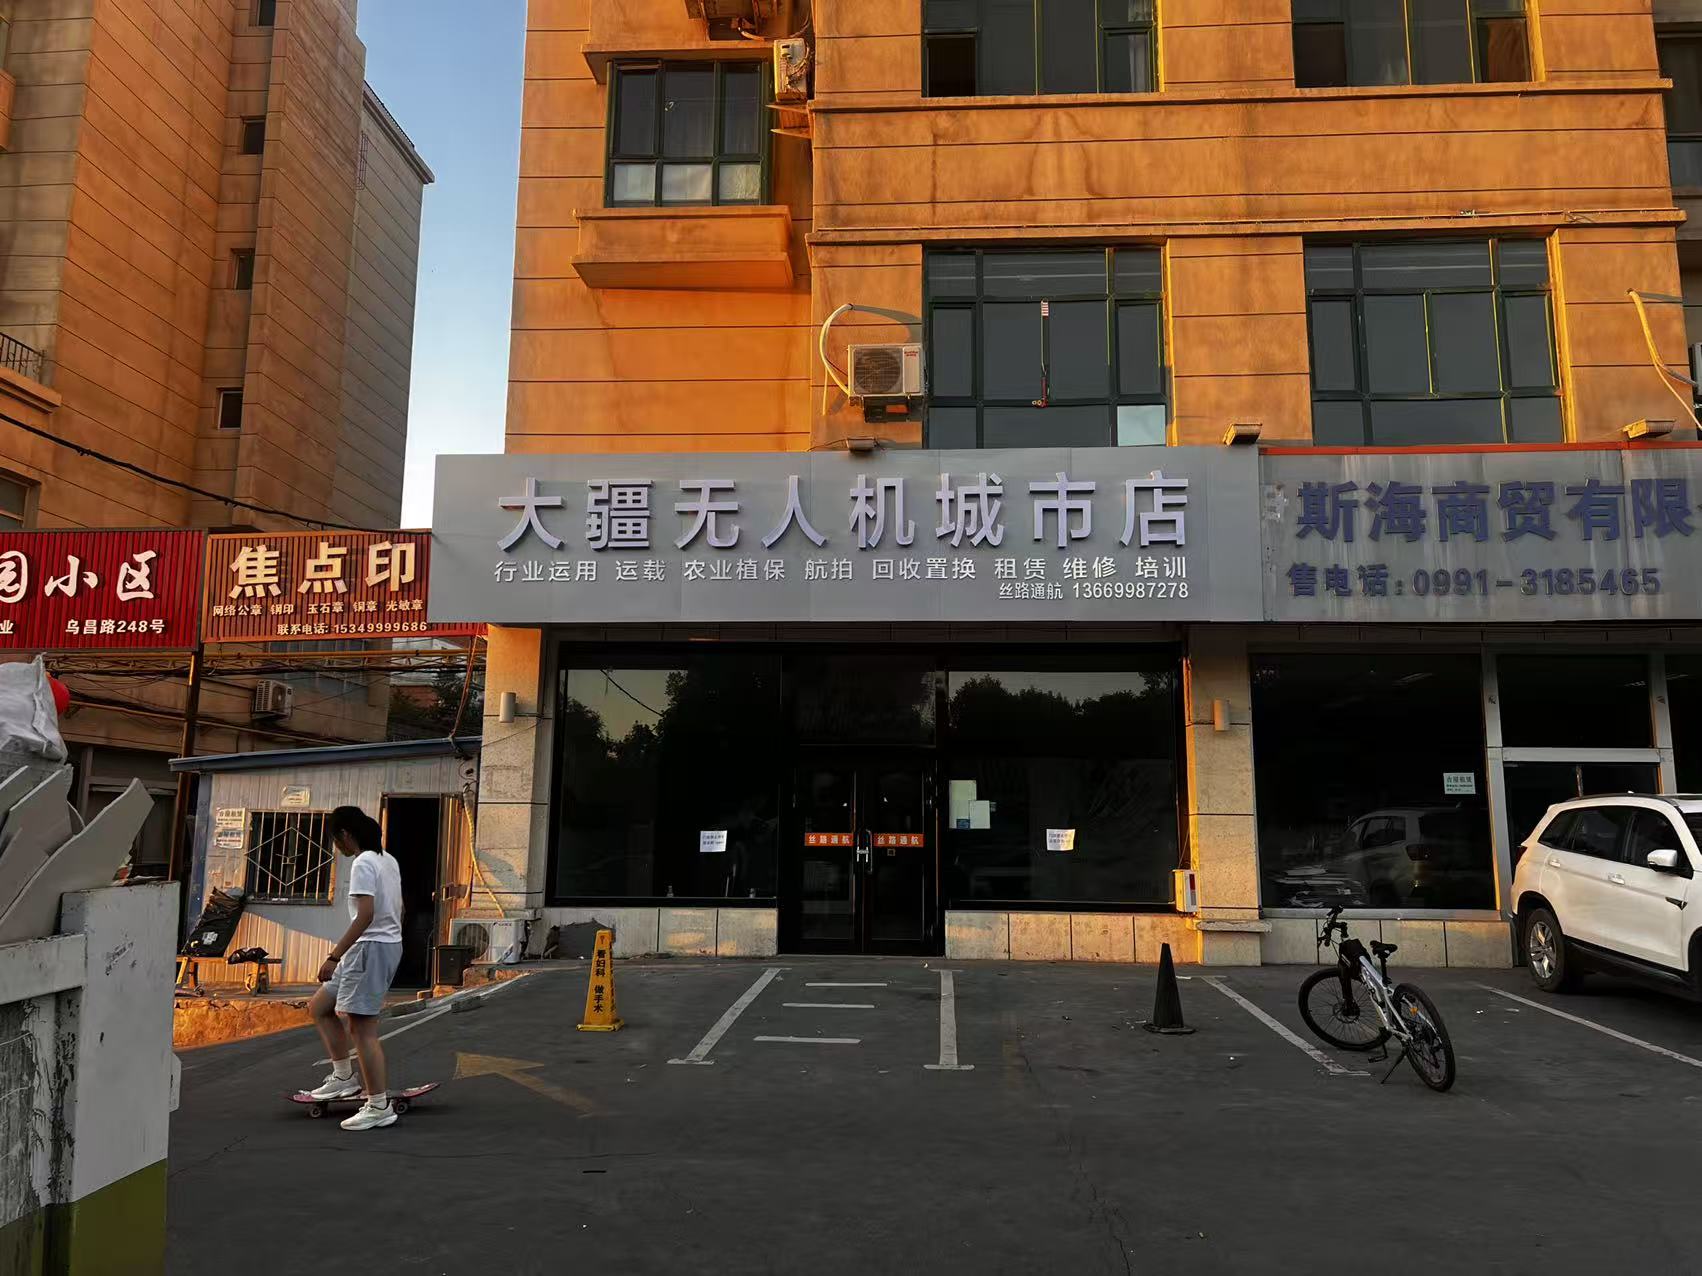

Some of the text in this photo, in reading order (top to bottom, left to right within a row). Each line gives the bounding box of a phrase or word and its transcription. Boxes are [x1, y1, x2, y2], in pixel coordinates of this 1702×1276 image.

[496, 471, 1189, 551] 大疆无人机城市店
[1295, 478, 1702, 542] 斯海商贸有限
[228, 541, 417, 601] 焦点印
[494, 556, 1187, 582] 行业运用 运载 农业植保 航拍 回收置换 租赁 维修 培训
[999, 582, 1189, 601] 丝路通航 13669987278
[65, 618, 165, 635] 乌昌路248号
